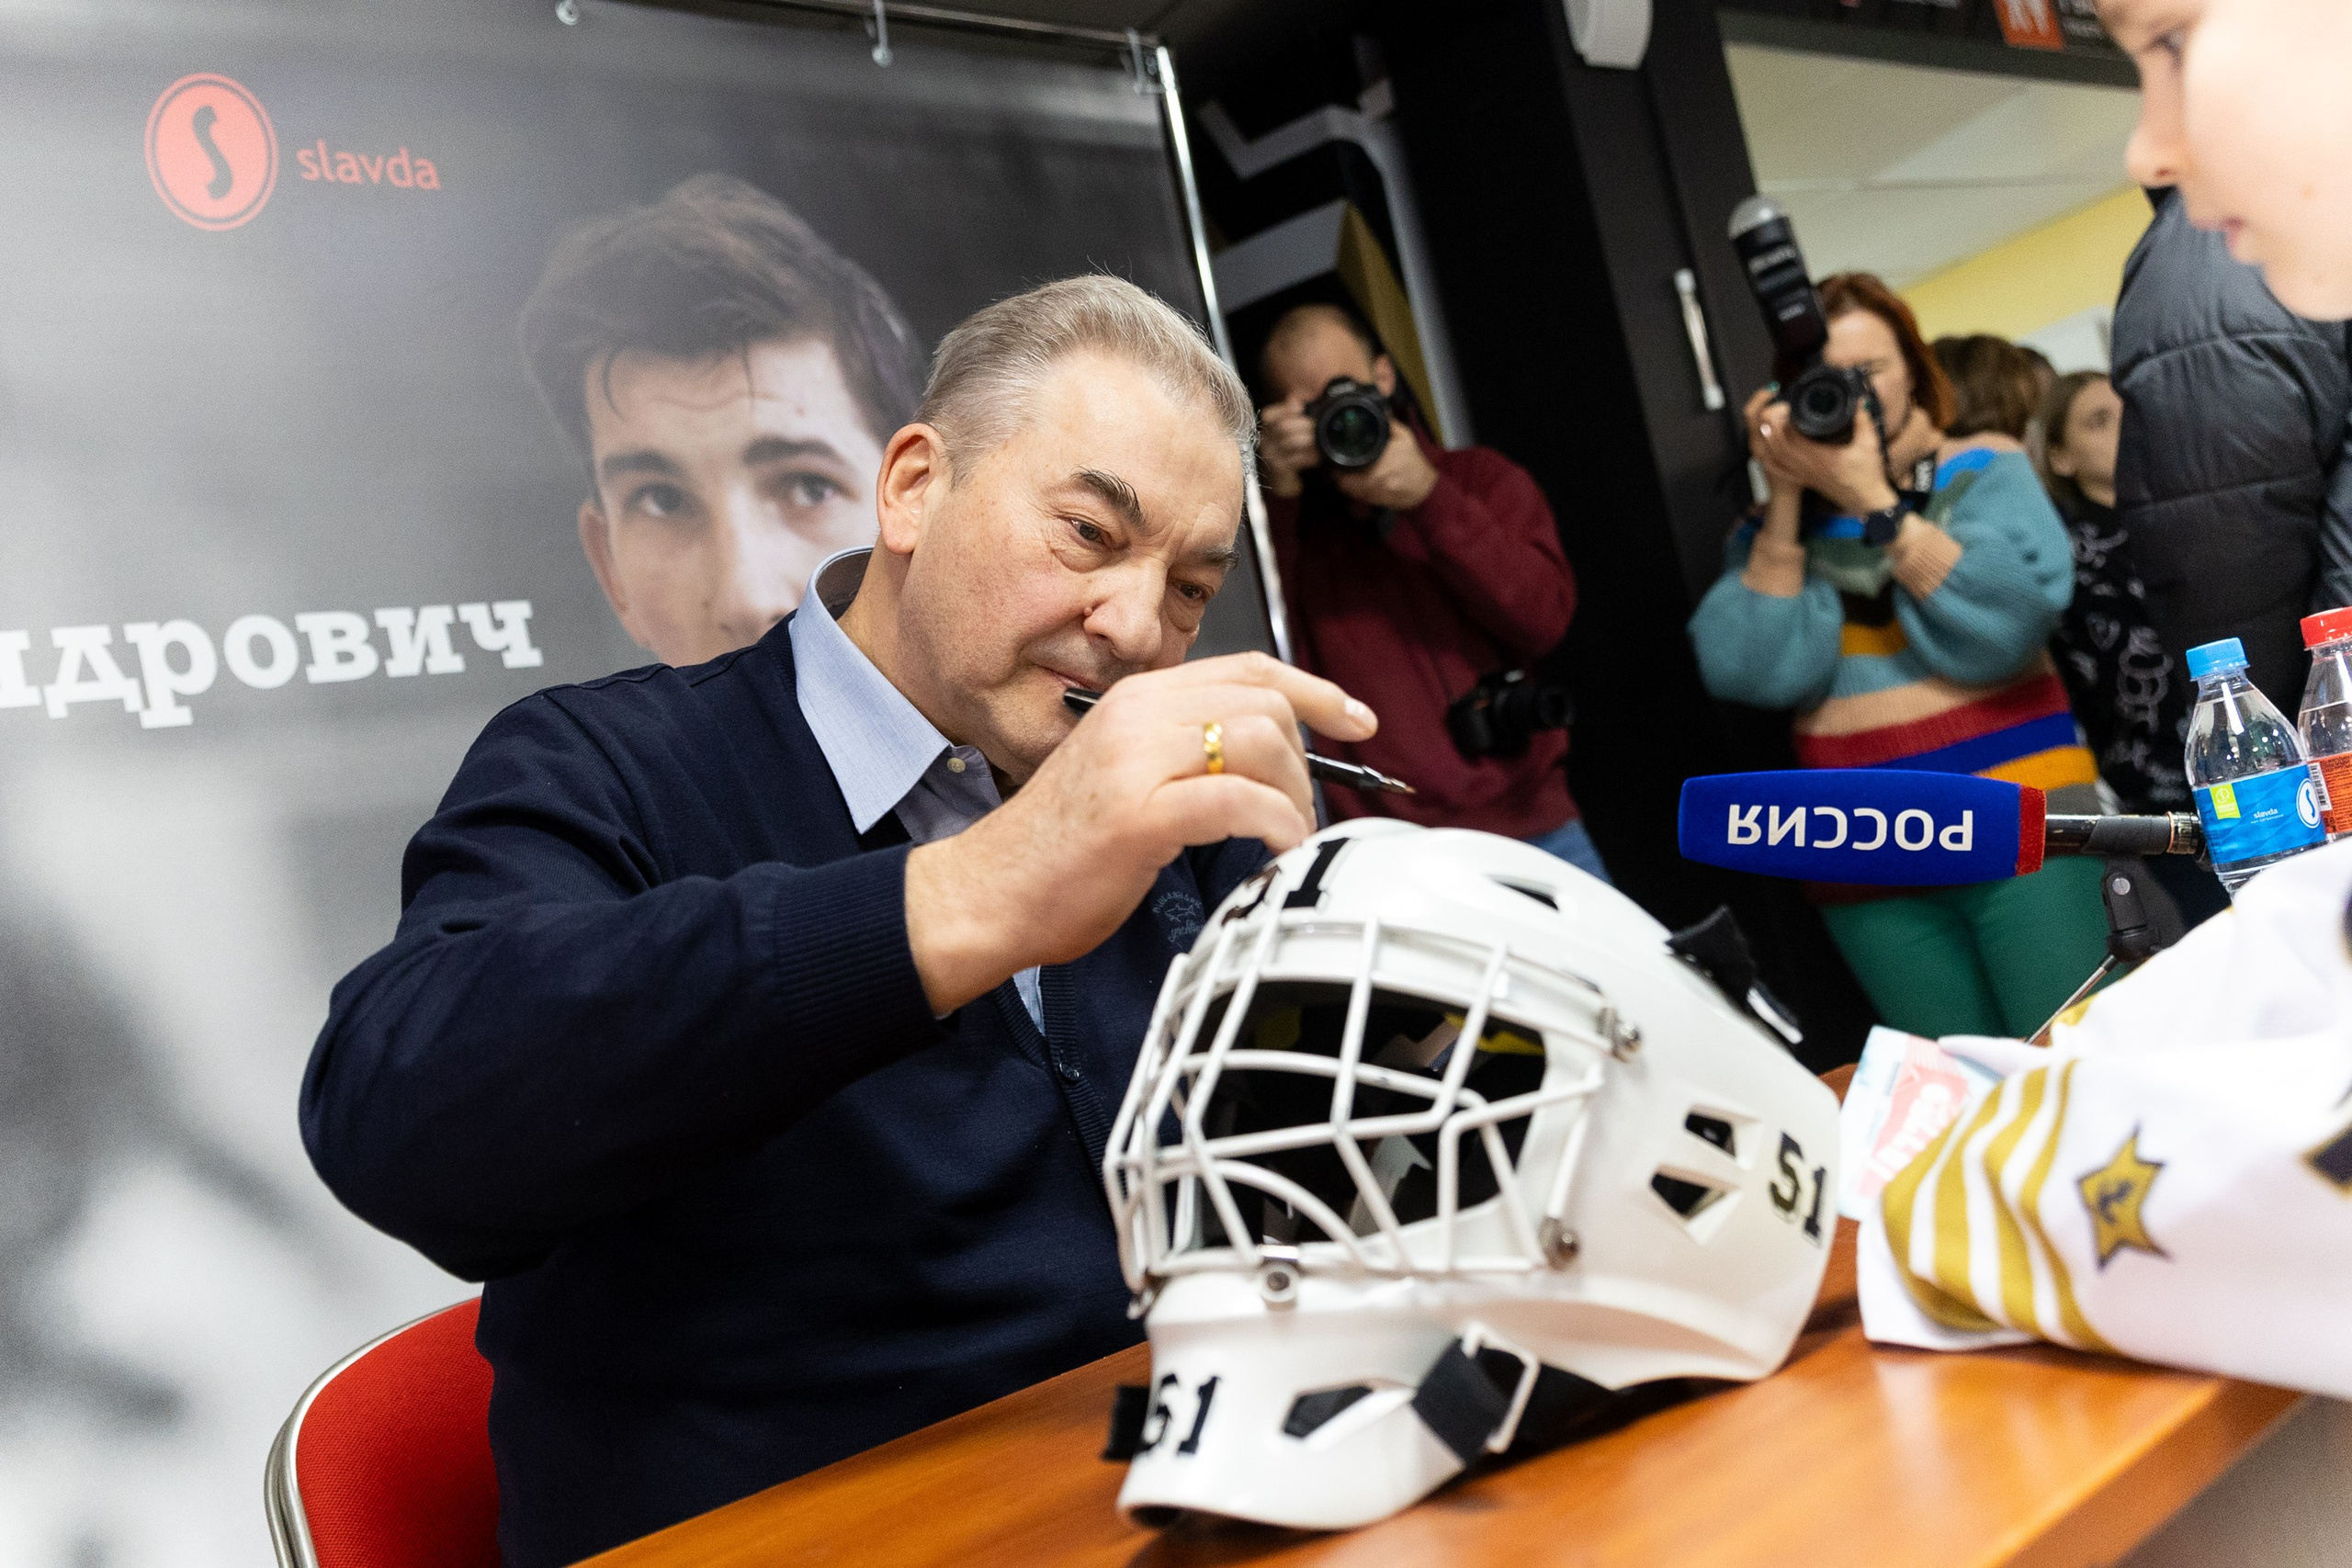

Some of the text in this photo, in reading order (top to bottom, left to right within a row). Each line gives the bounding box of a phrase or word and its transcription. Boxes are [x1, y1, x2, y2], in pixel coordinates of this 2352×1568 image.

[296, 139, 442, 191] slavda
[1727, 804, 1973, 852] РОССИЯ
[2253, 807, 2278, 819] slavda
[1770, 1130, 1827, 1242] 51
